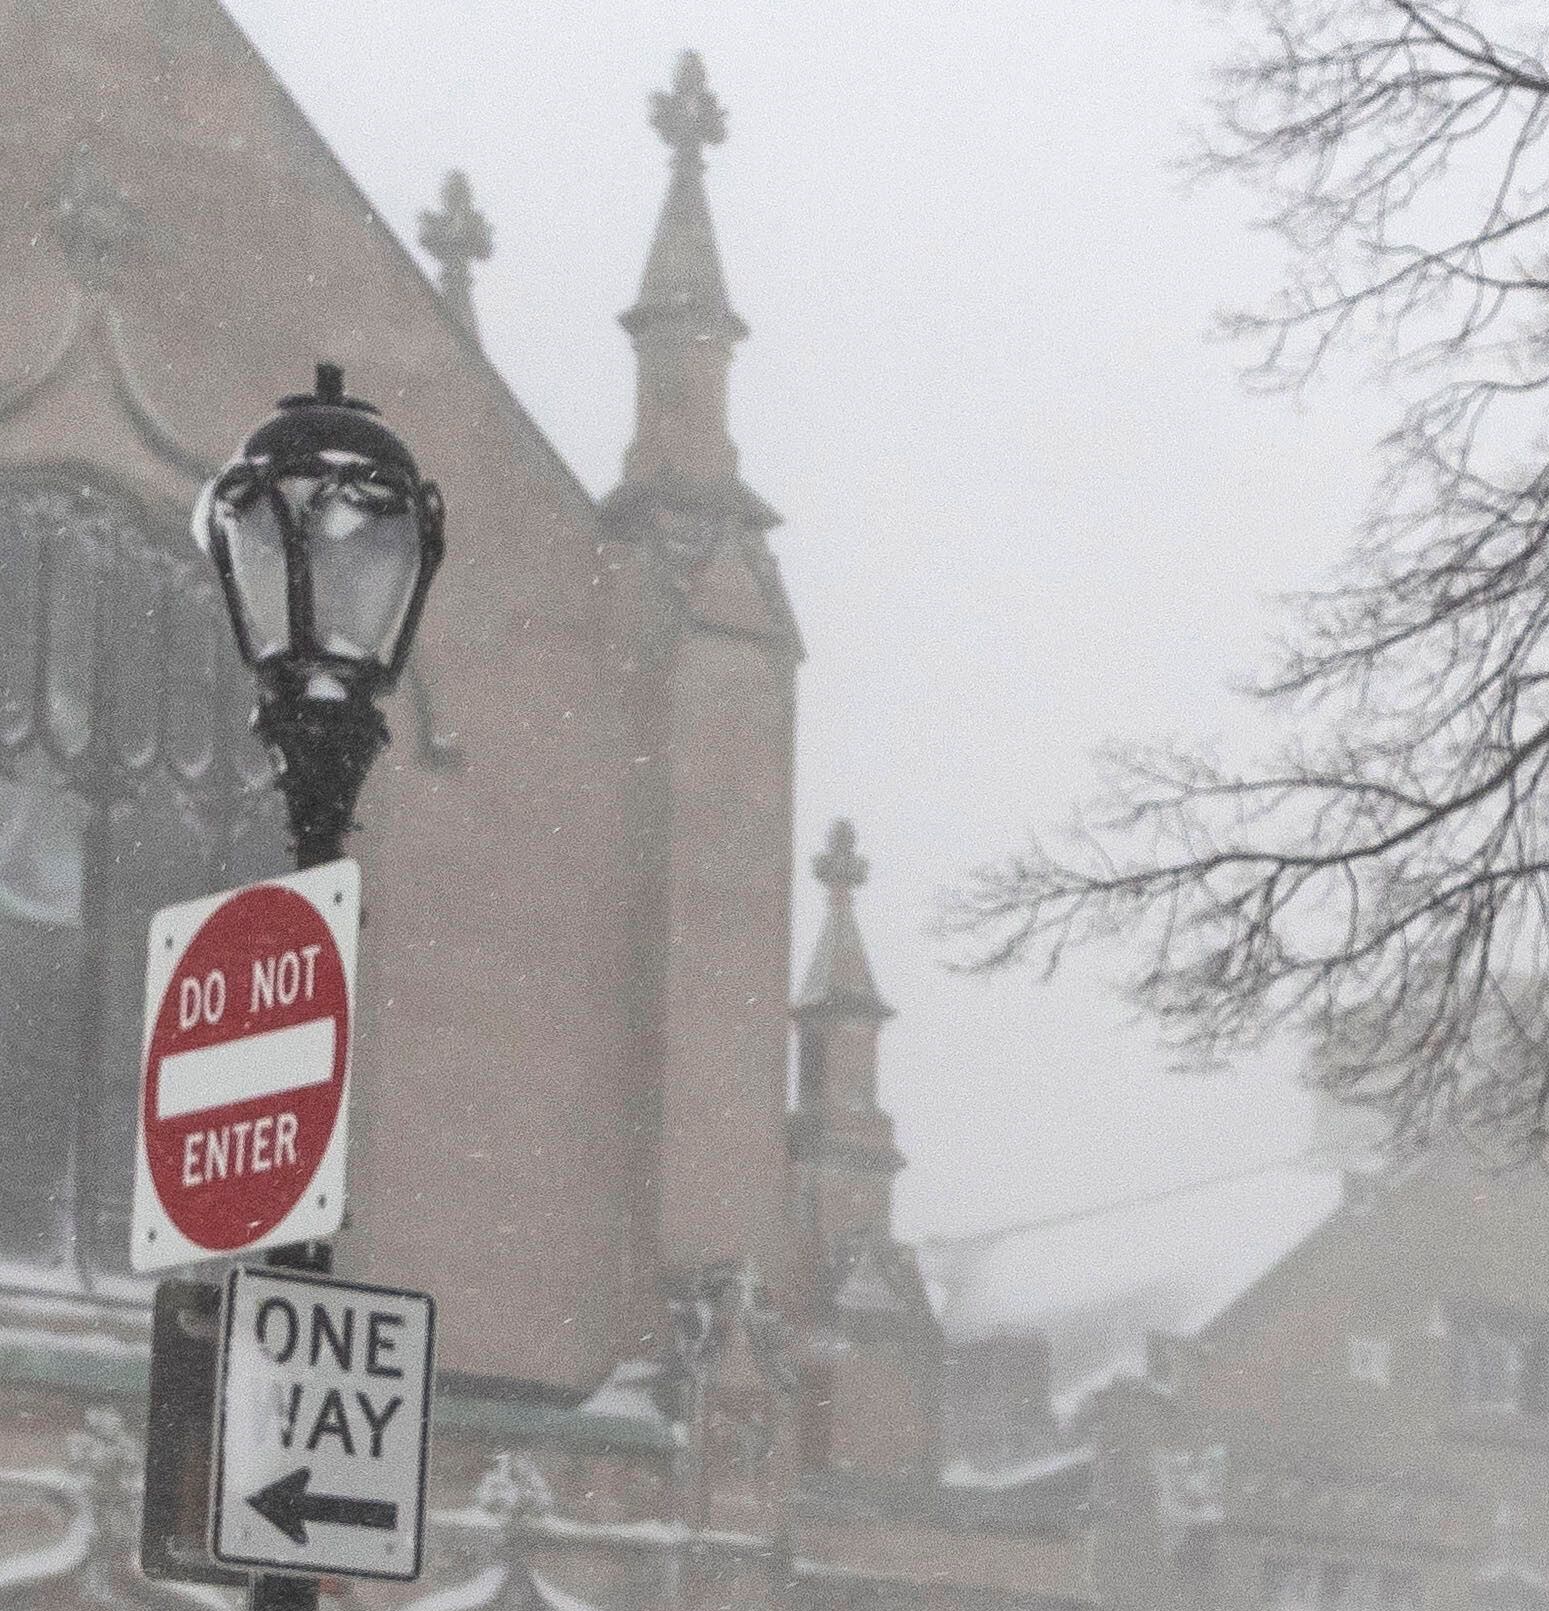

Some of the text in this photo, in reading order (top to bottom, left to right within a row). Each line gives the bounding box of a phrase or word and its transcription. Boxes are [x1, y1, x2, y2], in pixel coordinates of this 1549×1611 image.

[179, 945, 321, 1030] DO NOT
[182, 1112, 299, 1187] ENTER
[255, 1295, 404, 1379] ONE
